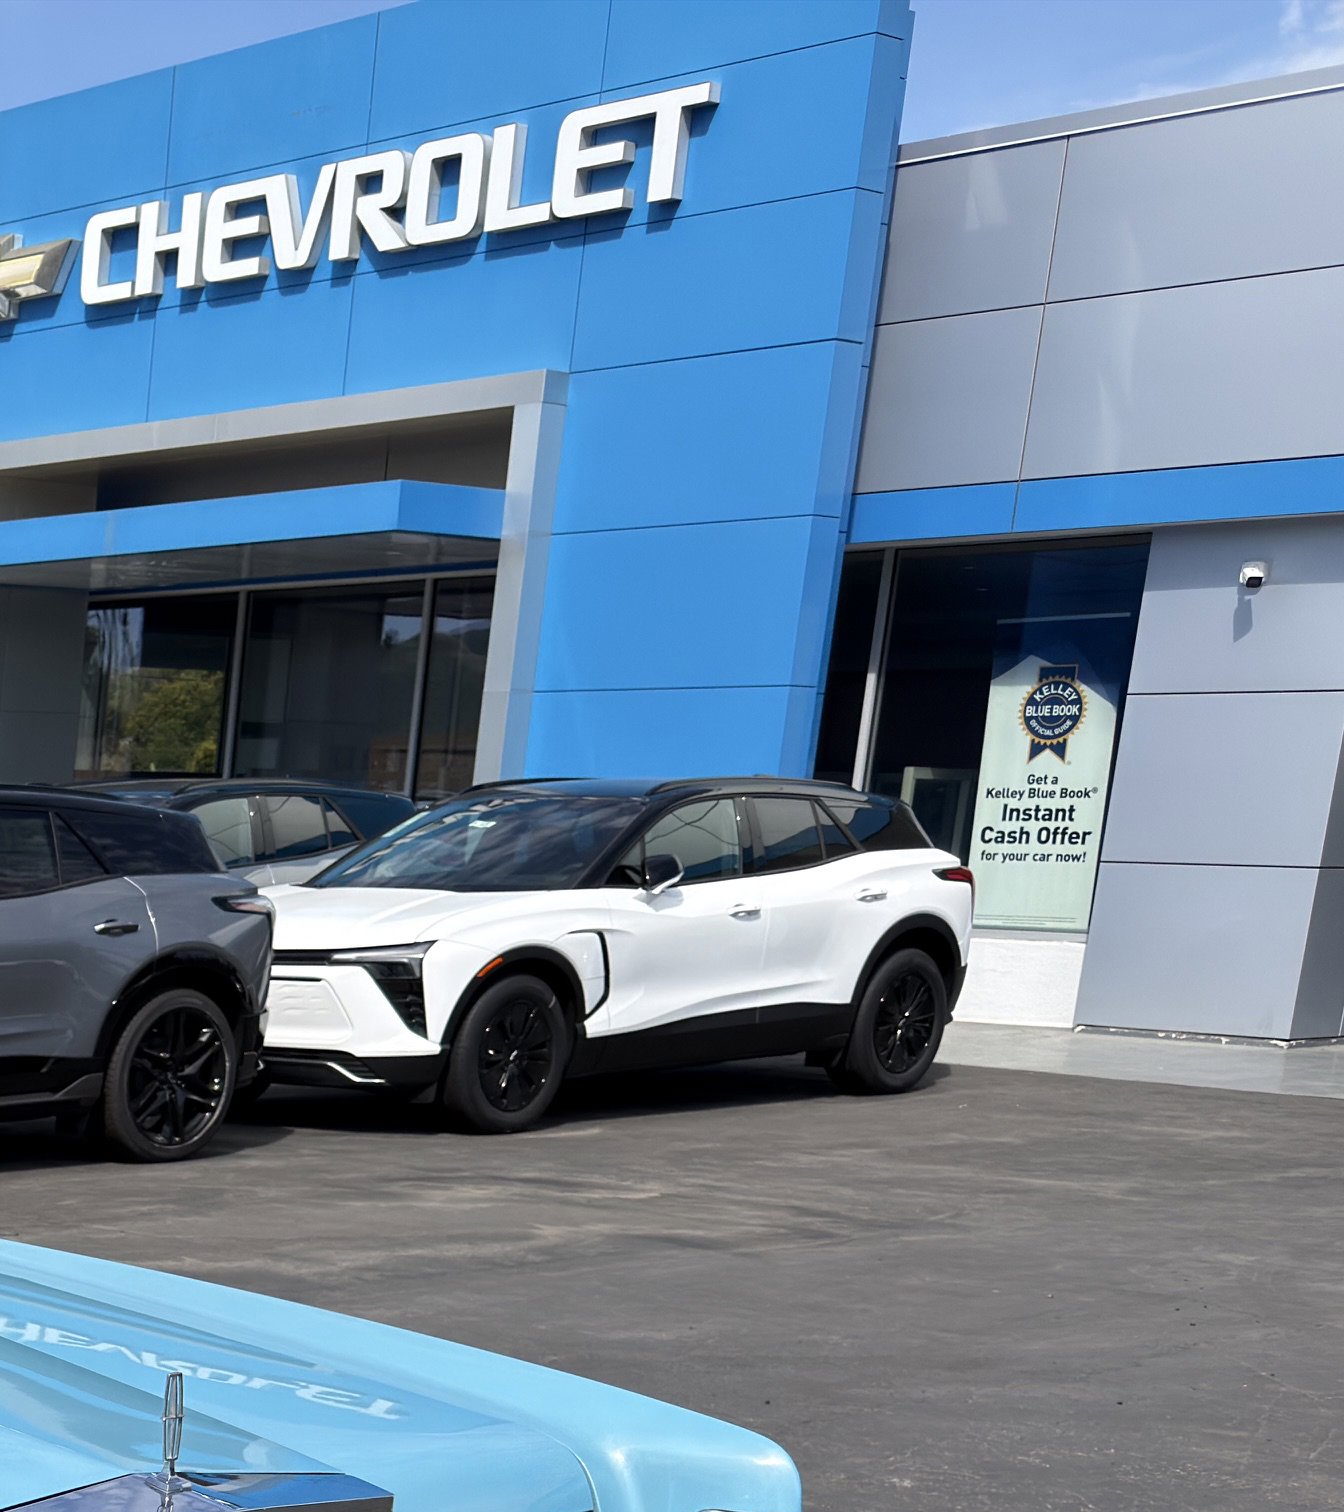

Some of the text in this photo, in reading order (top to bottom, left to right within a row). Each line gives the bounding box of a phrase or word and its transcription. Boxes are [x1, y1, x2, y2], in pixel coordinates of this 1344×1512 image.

[80, 81, 720, 305] CHEVROLET
[1033, 683, 1078, 702] KELLEY
[1025, 704, 1081, 717] BLUE BOOK
[1029, 719, 1054, 736] OFFICIAL
[1027, 774, 1059, 785] Get a
[985, 787, 1025, 801] Kelley
[1027, 787, 1056, 799] Blue
[1001, 803, 1076, 822] Instant
[980, 826, 1093, 846] Cash Offer
[980, 850, 1087, 864] for your car now!
